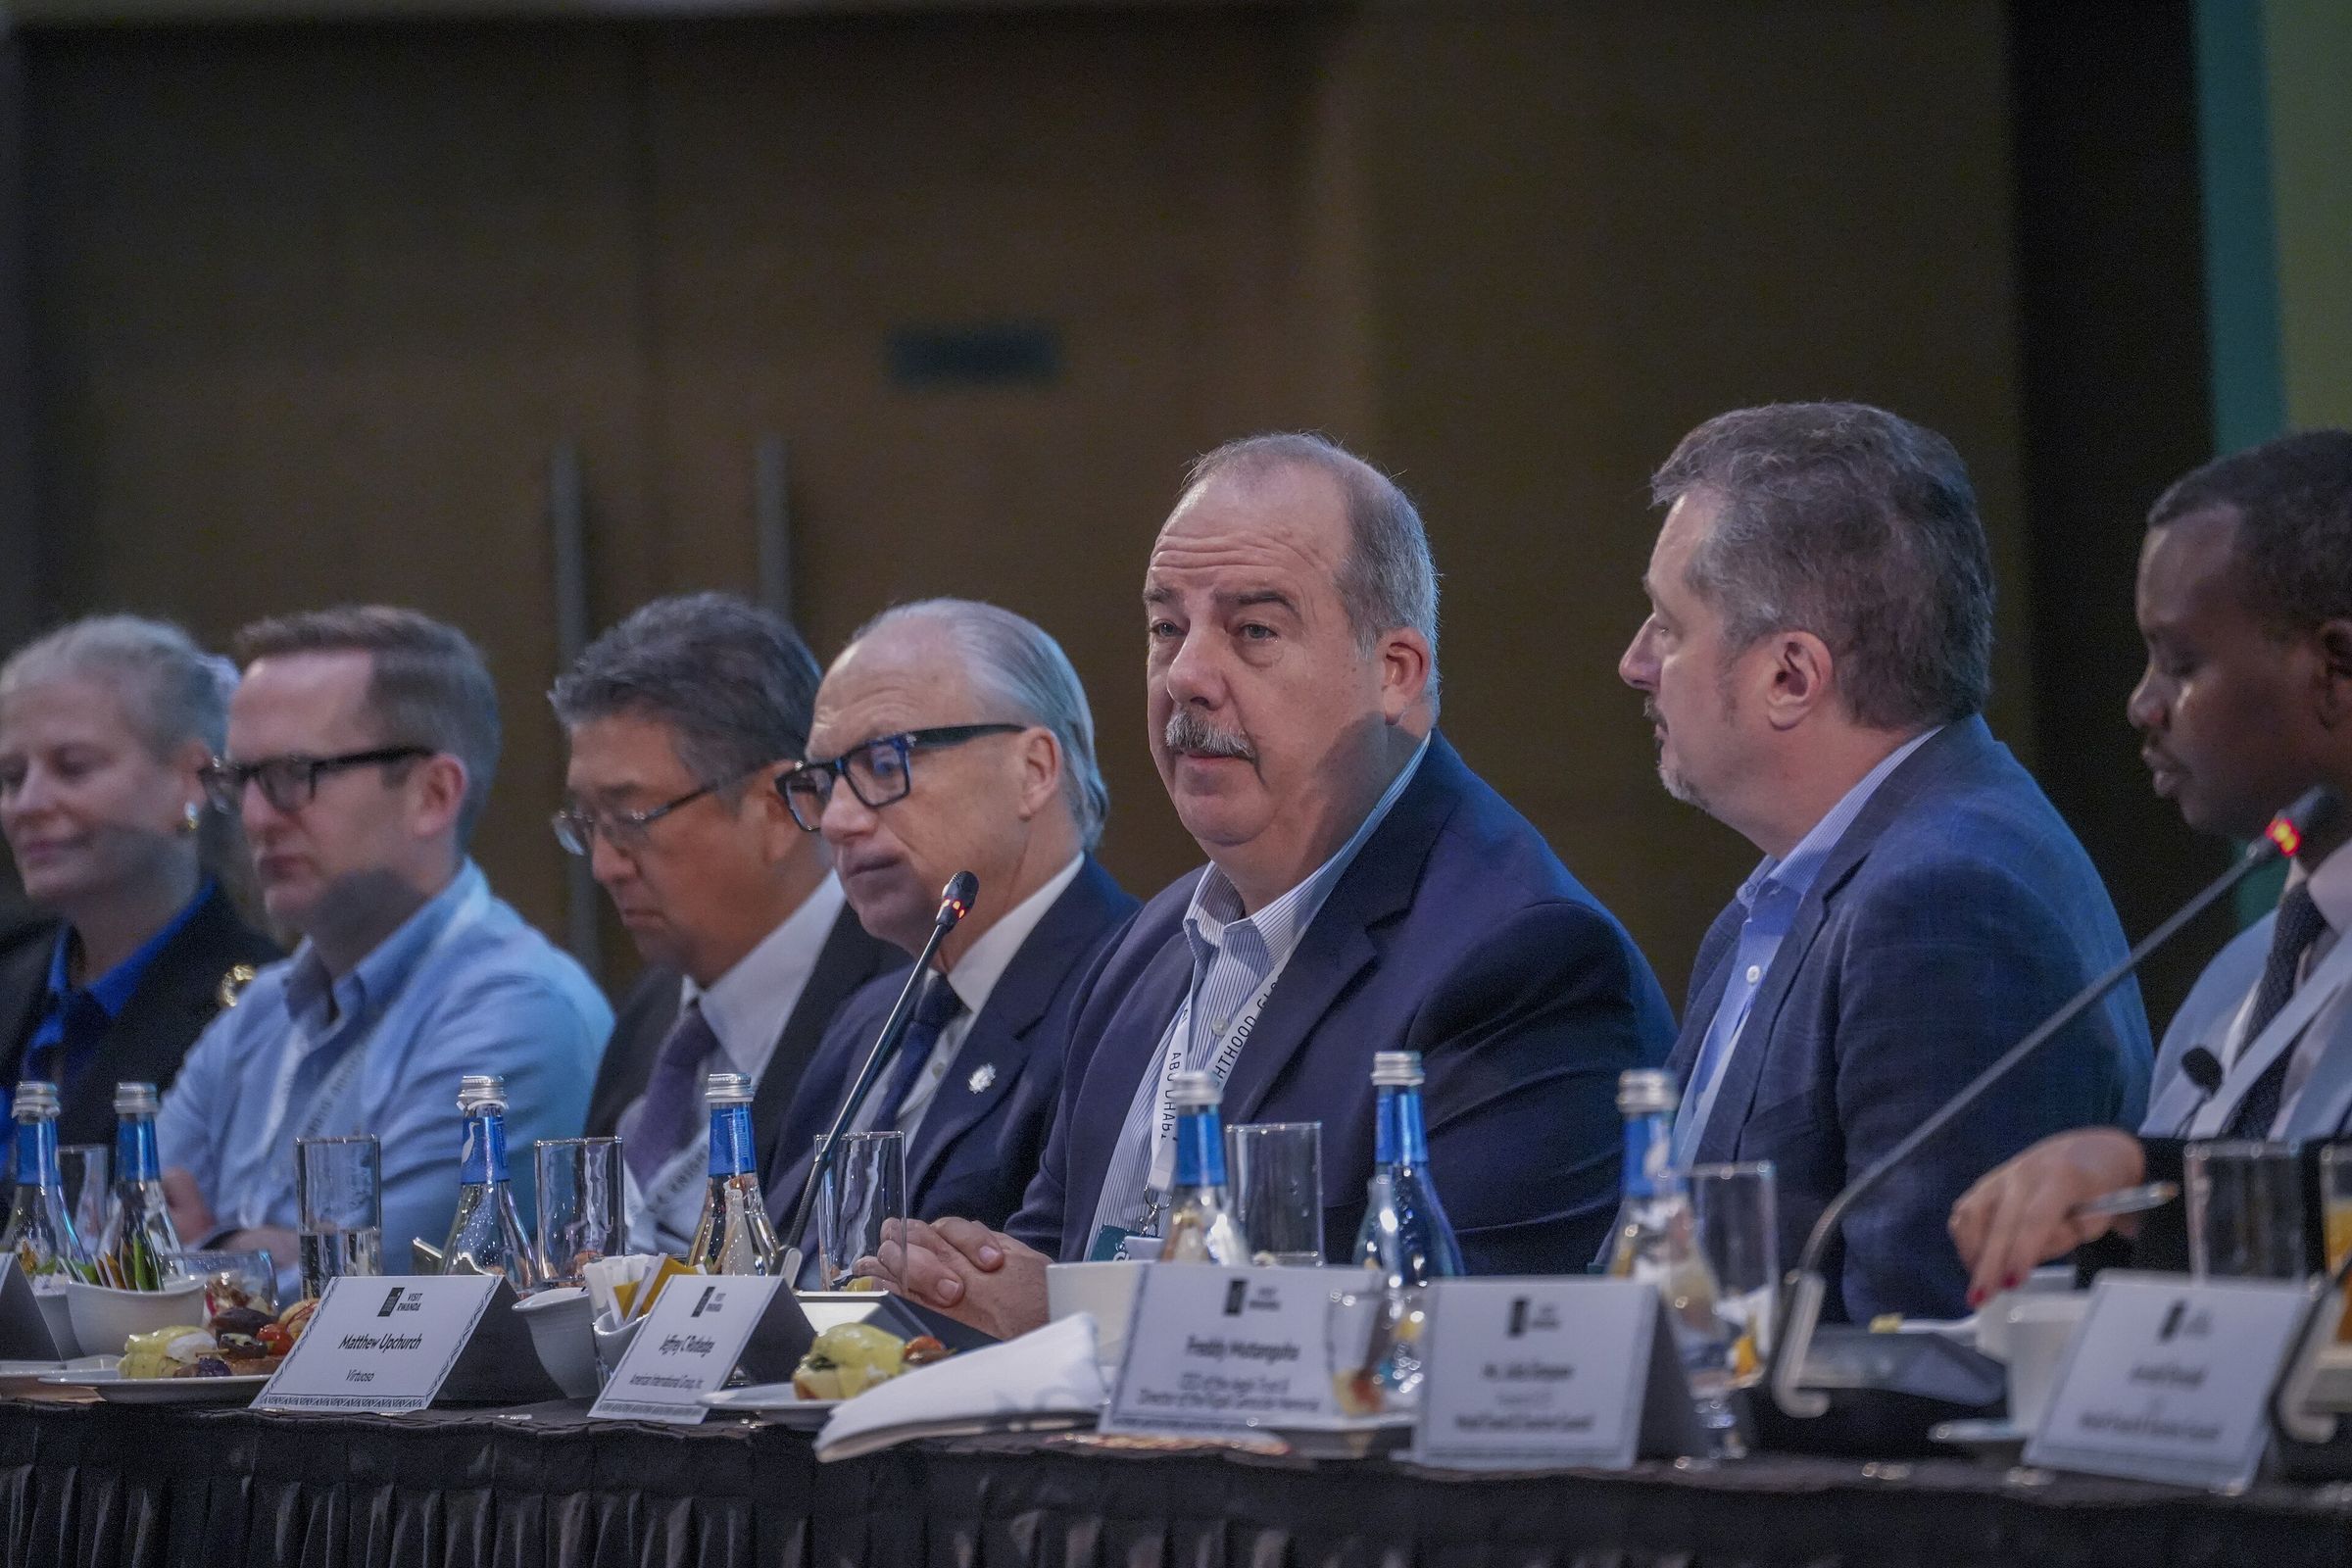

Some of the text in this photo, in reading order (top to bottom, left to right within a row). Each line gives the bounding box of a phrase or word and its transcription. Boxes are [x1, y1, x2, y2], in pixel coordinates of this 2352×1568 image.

[408, 1293, 422, 1301] VISIT
[397, 1302, 420, 1311] RWANDA
[338, 1333, 423, 1353] Matthew Upchurch
[345, 1368, 375, 1382] Virtuoso
